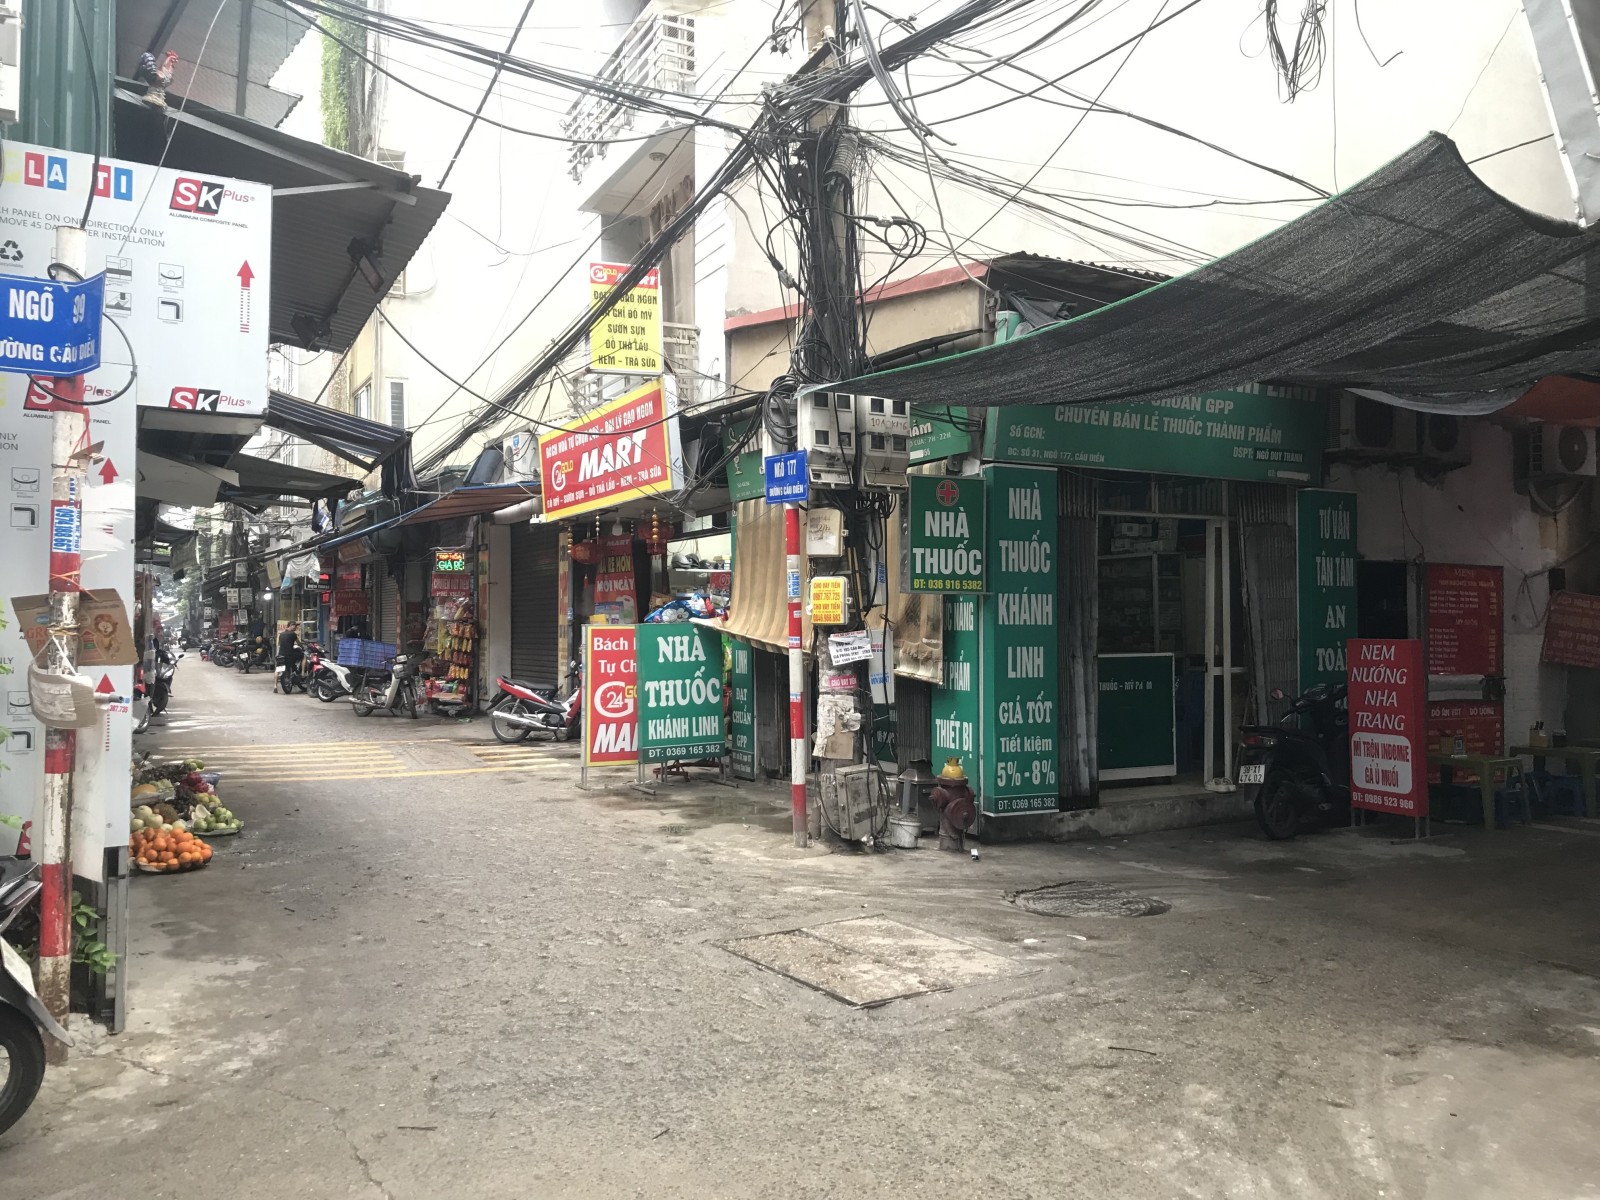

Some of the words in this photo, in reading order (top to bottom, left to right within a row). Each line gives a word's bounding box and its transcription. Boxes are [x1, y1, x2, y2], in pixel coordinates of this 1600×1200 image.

[12, 208, 42, 220] PANEL
[45, 213, 61, 222] ON
[87, 220, 137, 234] DIRECTION
[140, 228, 164, 238] ONLY
[30, 221, 42, 229] 45
[102, 231, 165, 247] INSTALLATION
[9, 286, 54, 322] NGÕ
[1206, 398, 1234, 415] GPP
[1023, 427, 1046, 439] GCN:
[1113, 410, 1140, 430] BÁN
[1163, 414, 1203, 436] THUỐC
[578, 429, 647, 482] MART
[787, 459, 797, 476] 177
[1009, 482, 1042, 520] NHÀ
[925, 507, 969, 538] NHÀ
[912, 540, 982, 575] THUỐC
[999, 530, 1050, 573] THUỐC
[613, 576, 635, 592] NGÀY
[928, 579, 943, 589] 036
[946, 580, 960, 590] 916
[962, 581, 982, 590] 5382
[954, 595, 974, 632] NĂNG
[998, 587, 1052, 625] KHÁNH
[1325, 604, 1346, 628] AN
[593, 637, 628, 651] Bách
[657, 627, 706, 663] NHÀ
[1361, 644, 1395, 661] NEM
[598, 660, 616, 677] Tự
[620, 659, 637, 673] Ch
[950, 649, 970, 691] PHẨM
[1008, 647, 1043, 678] LINH
[1351, 664, 1407, 685] NƯỚNG
[645, 666, 720, 708] THUỐC
[1364, 689, 1398, 707] NHA
[999, 695, 1023, 724] GIÁ
[1026, 691, 1052, 723] TỐT
[648, 714, 689, 740] KHÁNH
[692, 716, 719, 737] LINH
[1356, 711, 1406, 731] TRANG
[736, 734, 748, 748] GPP
[935, 710, 960, 750] THIẾT
[962, 721, 973, 759] BỊ
[1000, 734, 1021, 753] Tiết
[1024, 736, 1052, 755] kiệm
[667, 747, 686, 756] 0369
[689, 746, 703, 755] 165
[706, 744, 720, 753] 382
[997, 761, 1021, 787] 5%
[1032, 759, 1055, 786] 8%
[1365, 763, 1374, 785] GÀ
[1381, 765, 1399, 788] MUỐI
[1384, 797, 1397, 807] 523
